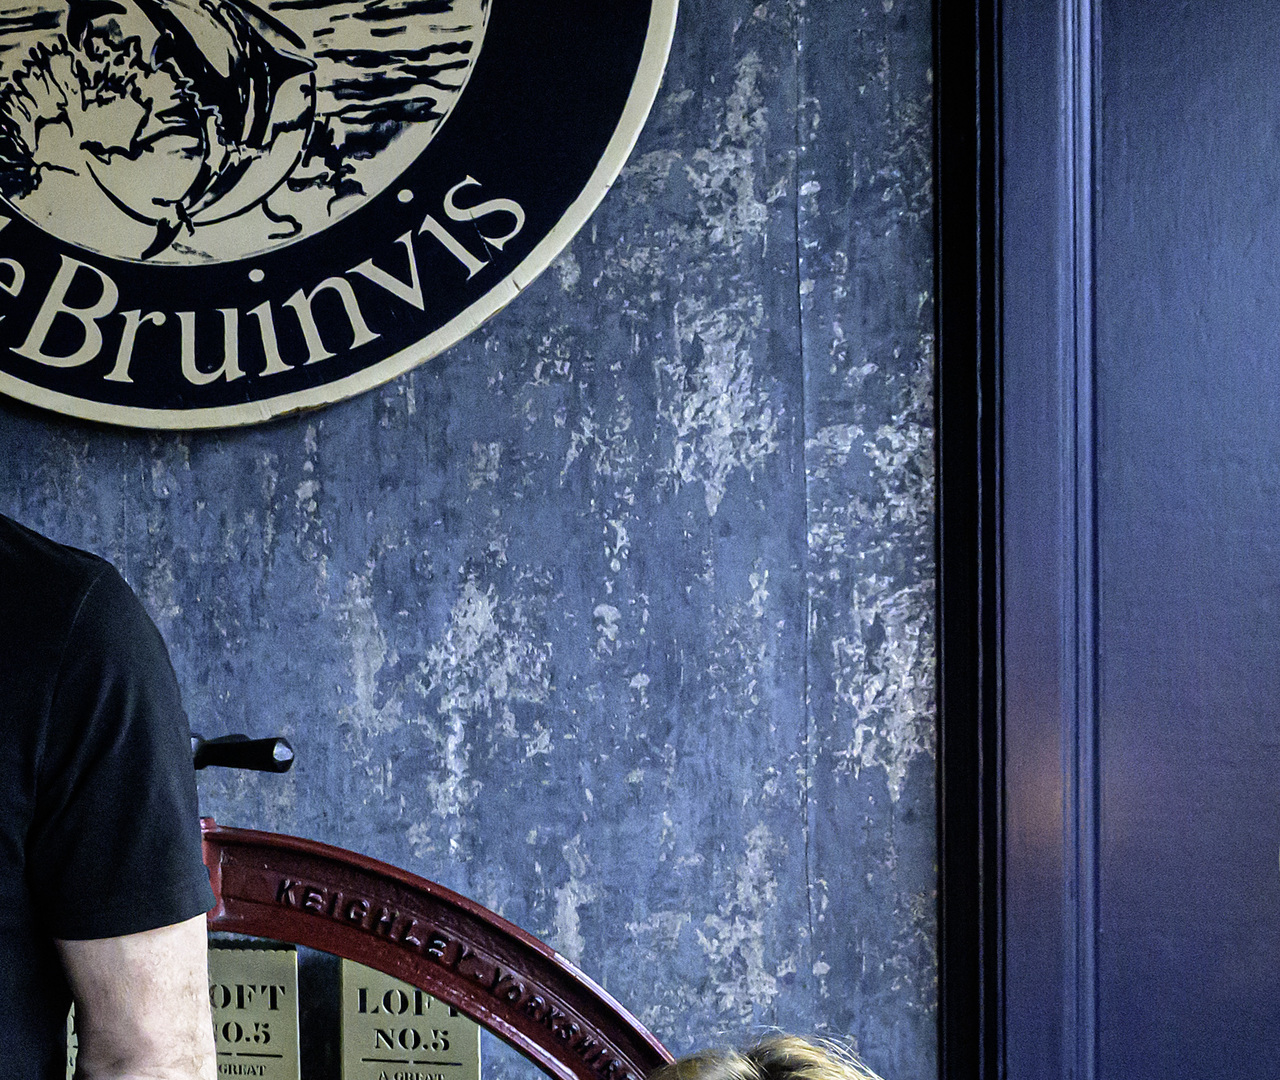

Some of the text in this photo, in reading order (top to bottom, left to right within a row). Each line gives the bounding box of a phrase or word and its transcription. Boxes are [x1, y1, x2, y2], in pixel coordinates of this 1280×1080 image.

[209, 984, 286, 1011] OFT
[213, 1021, 271, 1044] O.5
[373, 1028, 451, 1051] NO.5
[218, 1064, 267, 1076] GREAT
